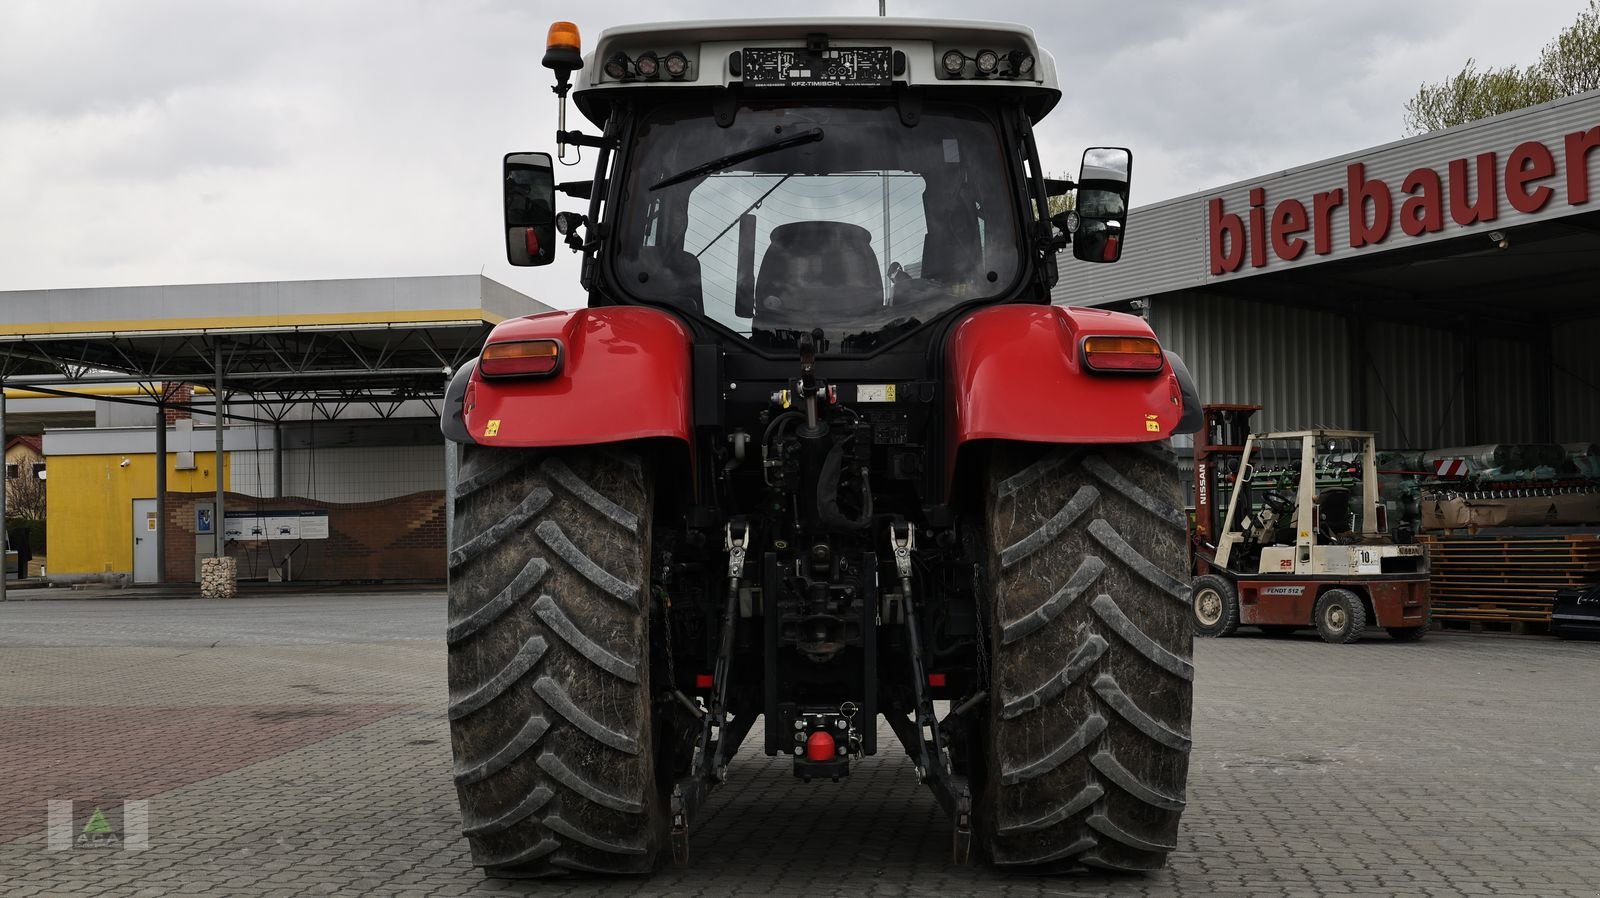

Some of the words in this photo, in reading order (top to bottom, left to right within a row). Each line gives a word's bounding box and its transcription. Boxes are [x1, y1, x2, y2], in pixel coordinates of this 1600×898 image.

[1208, 125, 1600, 275] bierbauer
[1280, 559, 1292, 567] 25
[1360, 551, 1370, 563] 10
